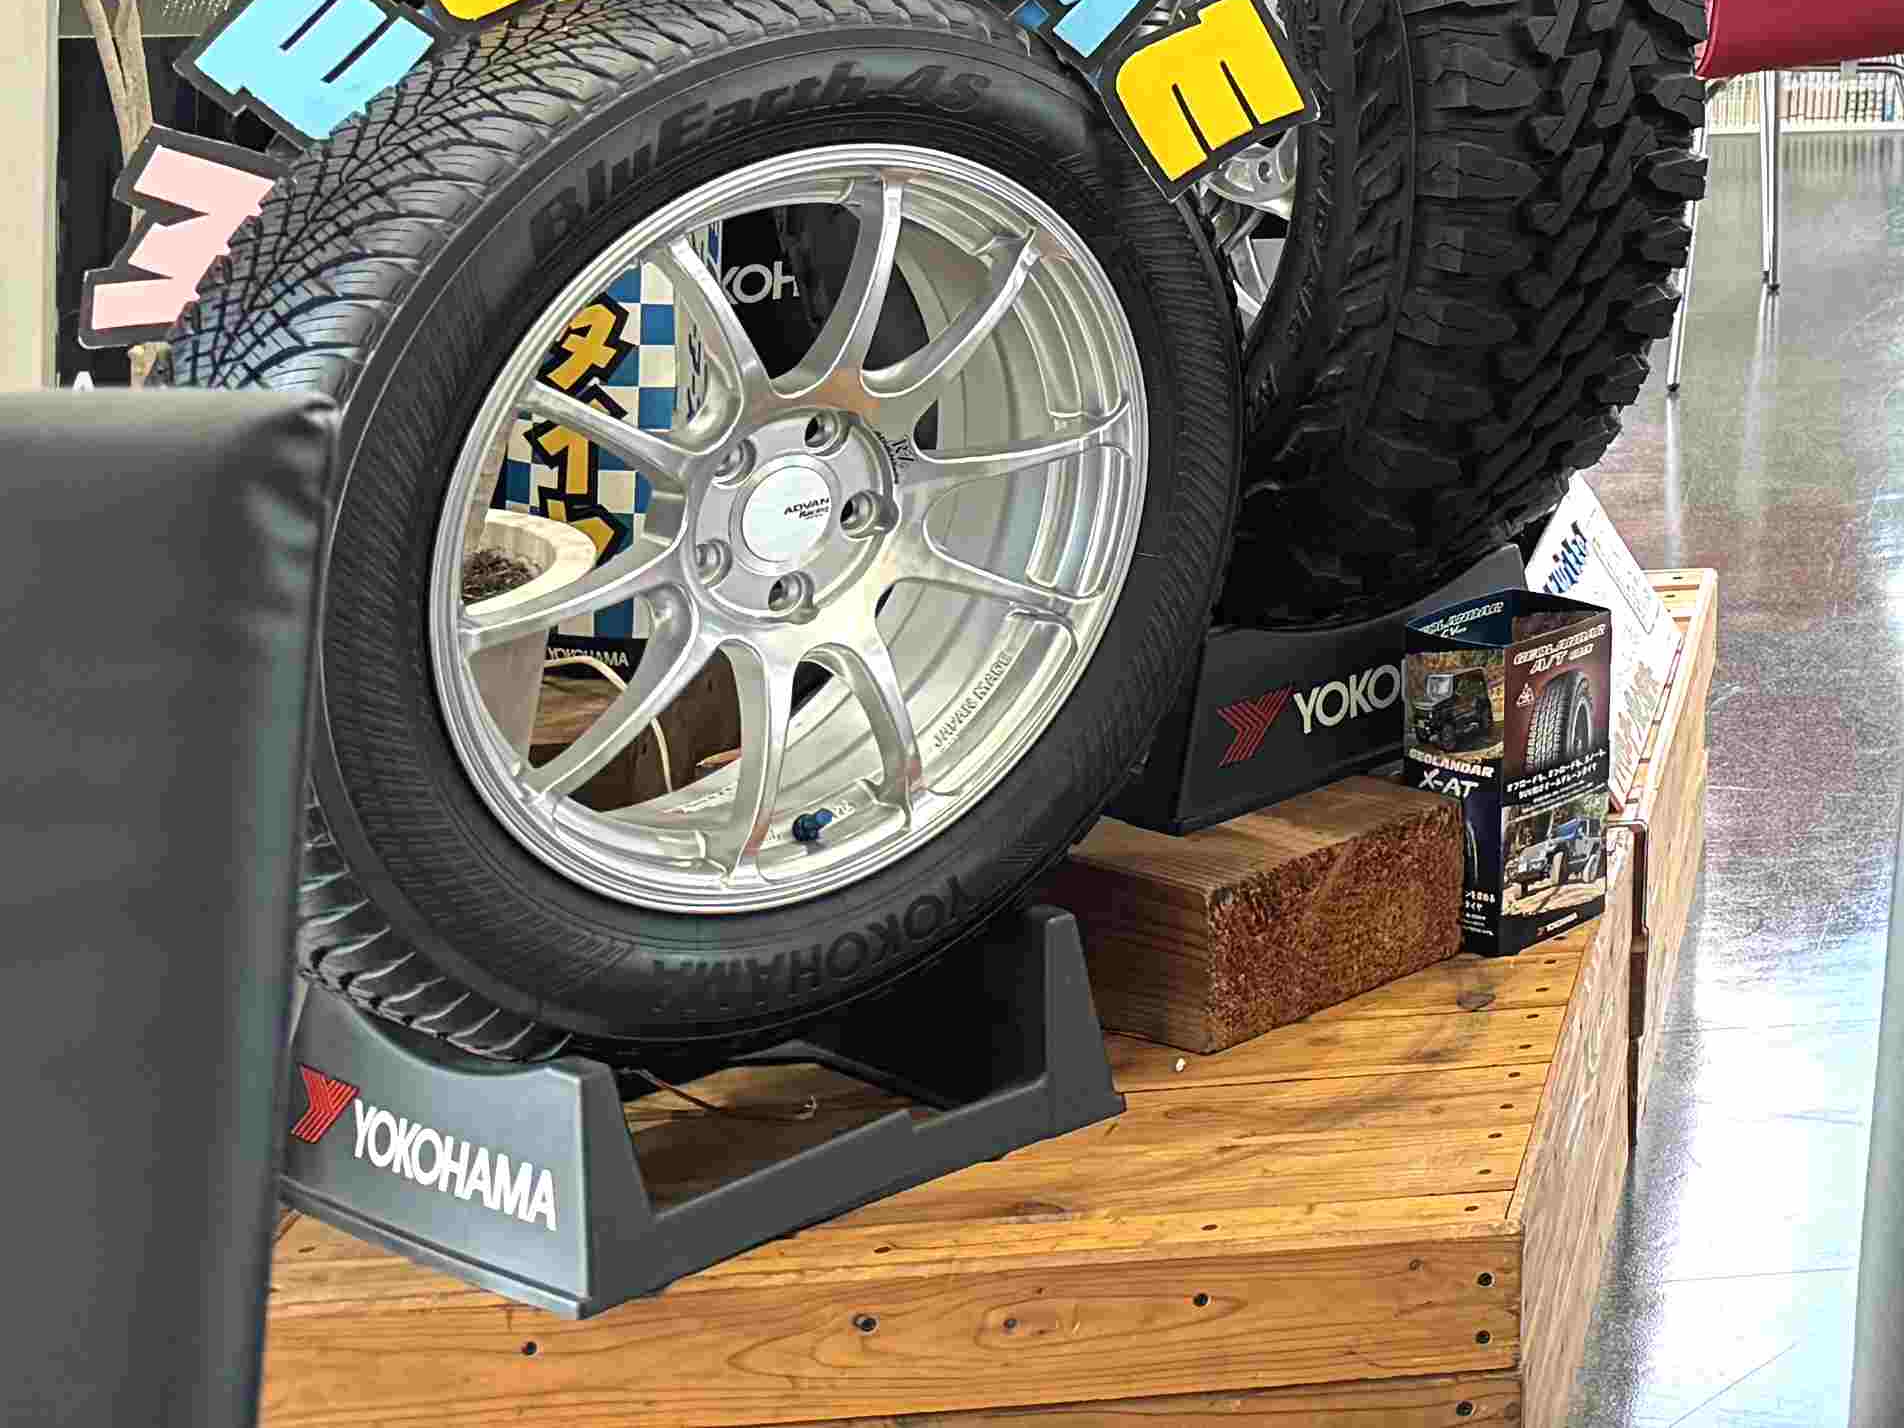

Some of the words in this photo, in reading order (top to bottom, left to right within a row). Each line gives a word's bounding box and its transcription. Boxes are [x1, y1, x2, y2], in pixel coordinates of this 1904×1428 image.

[784, 498, 829, 515] ADVAN
[1294, 663, 1404, 736] YOKO
[1408, 748, 1495, 778] GEOLANDAR
[1419, 770, 1479, 798] X-AT
[352, 1096, 559, 1232] YOKOHAMA
